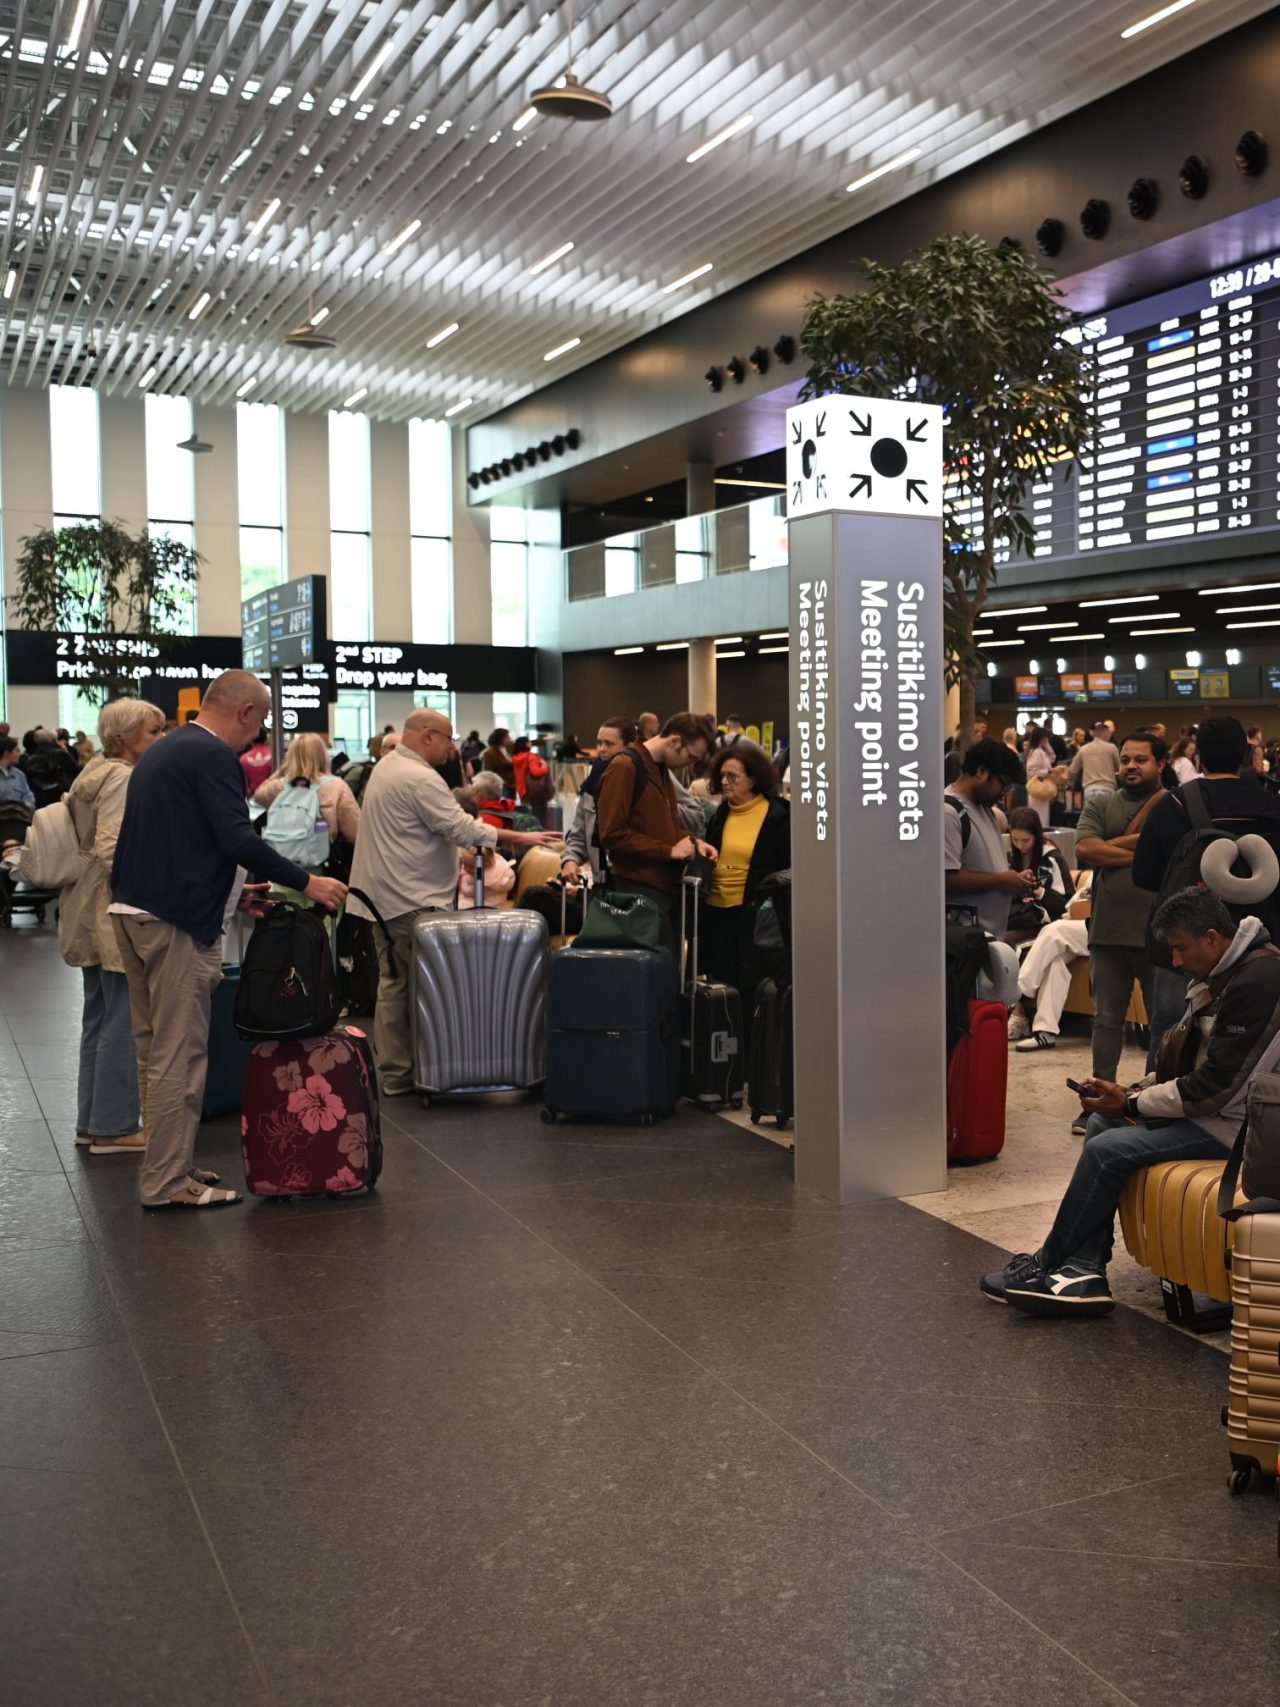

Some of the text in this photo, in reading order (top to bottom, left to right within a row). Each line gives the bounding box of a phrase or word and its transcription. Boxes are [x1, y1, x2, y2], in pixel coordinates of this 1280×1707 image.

[56, 638, 69, 655] 2
[336, 667, 375, 687] Drop
[377, 670, 414, 688] your
[417, 669, 448, 689] bag
[362, 647, 403, 664] STEP
[797, 582, 813, 803] Meeting point
[815, 580, 829, 841] Susitikimo vieta
[854, 580, 890, 806] Meeting point
[897, 581, 926, 841] Susitikimo vieta
